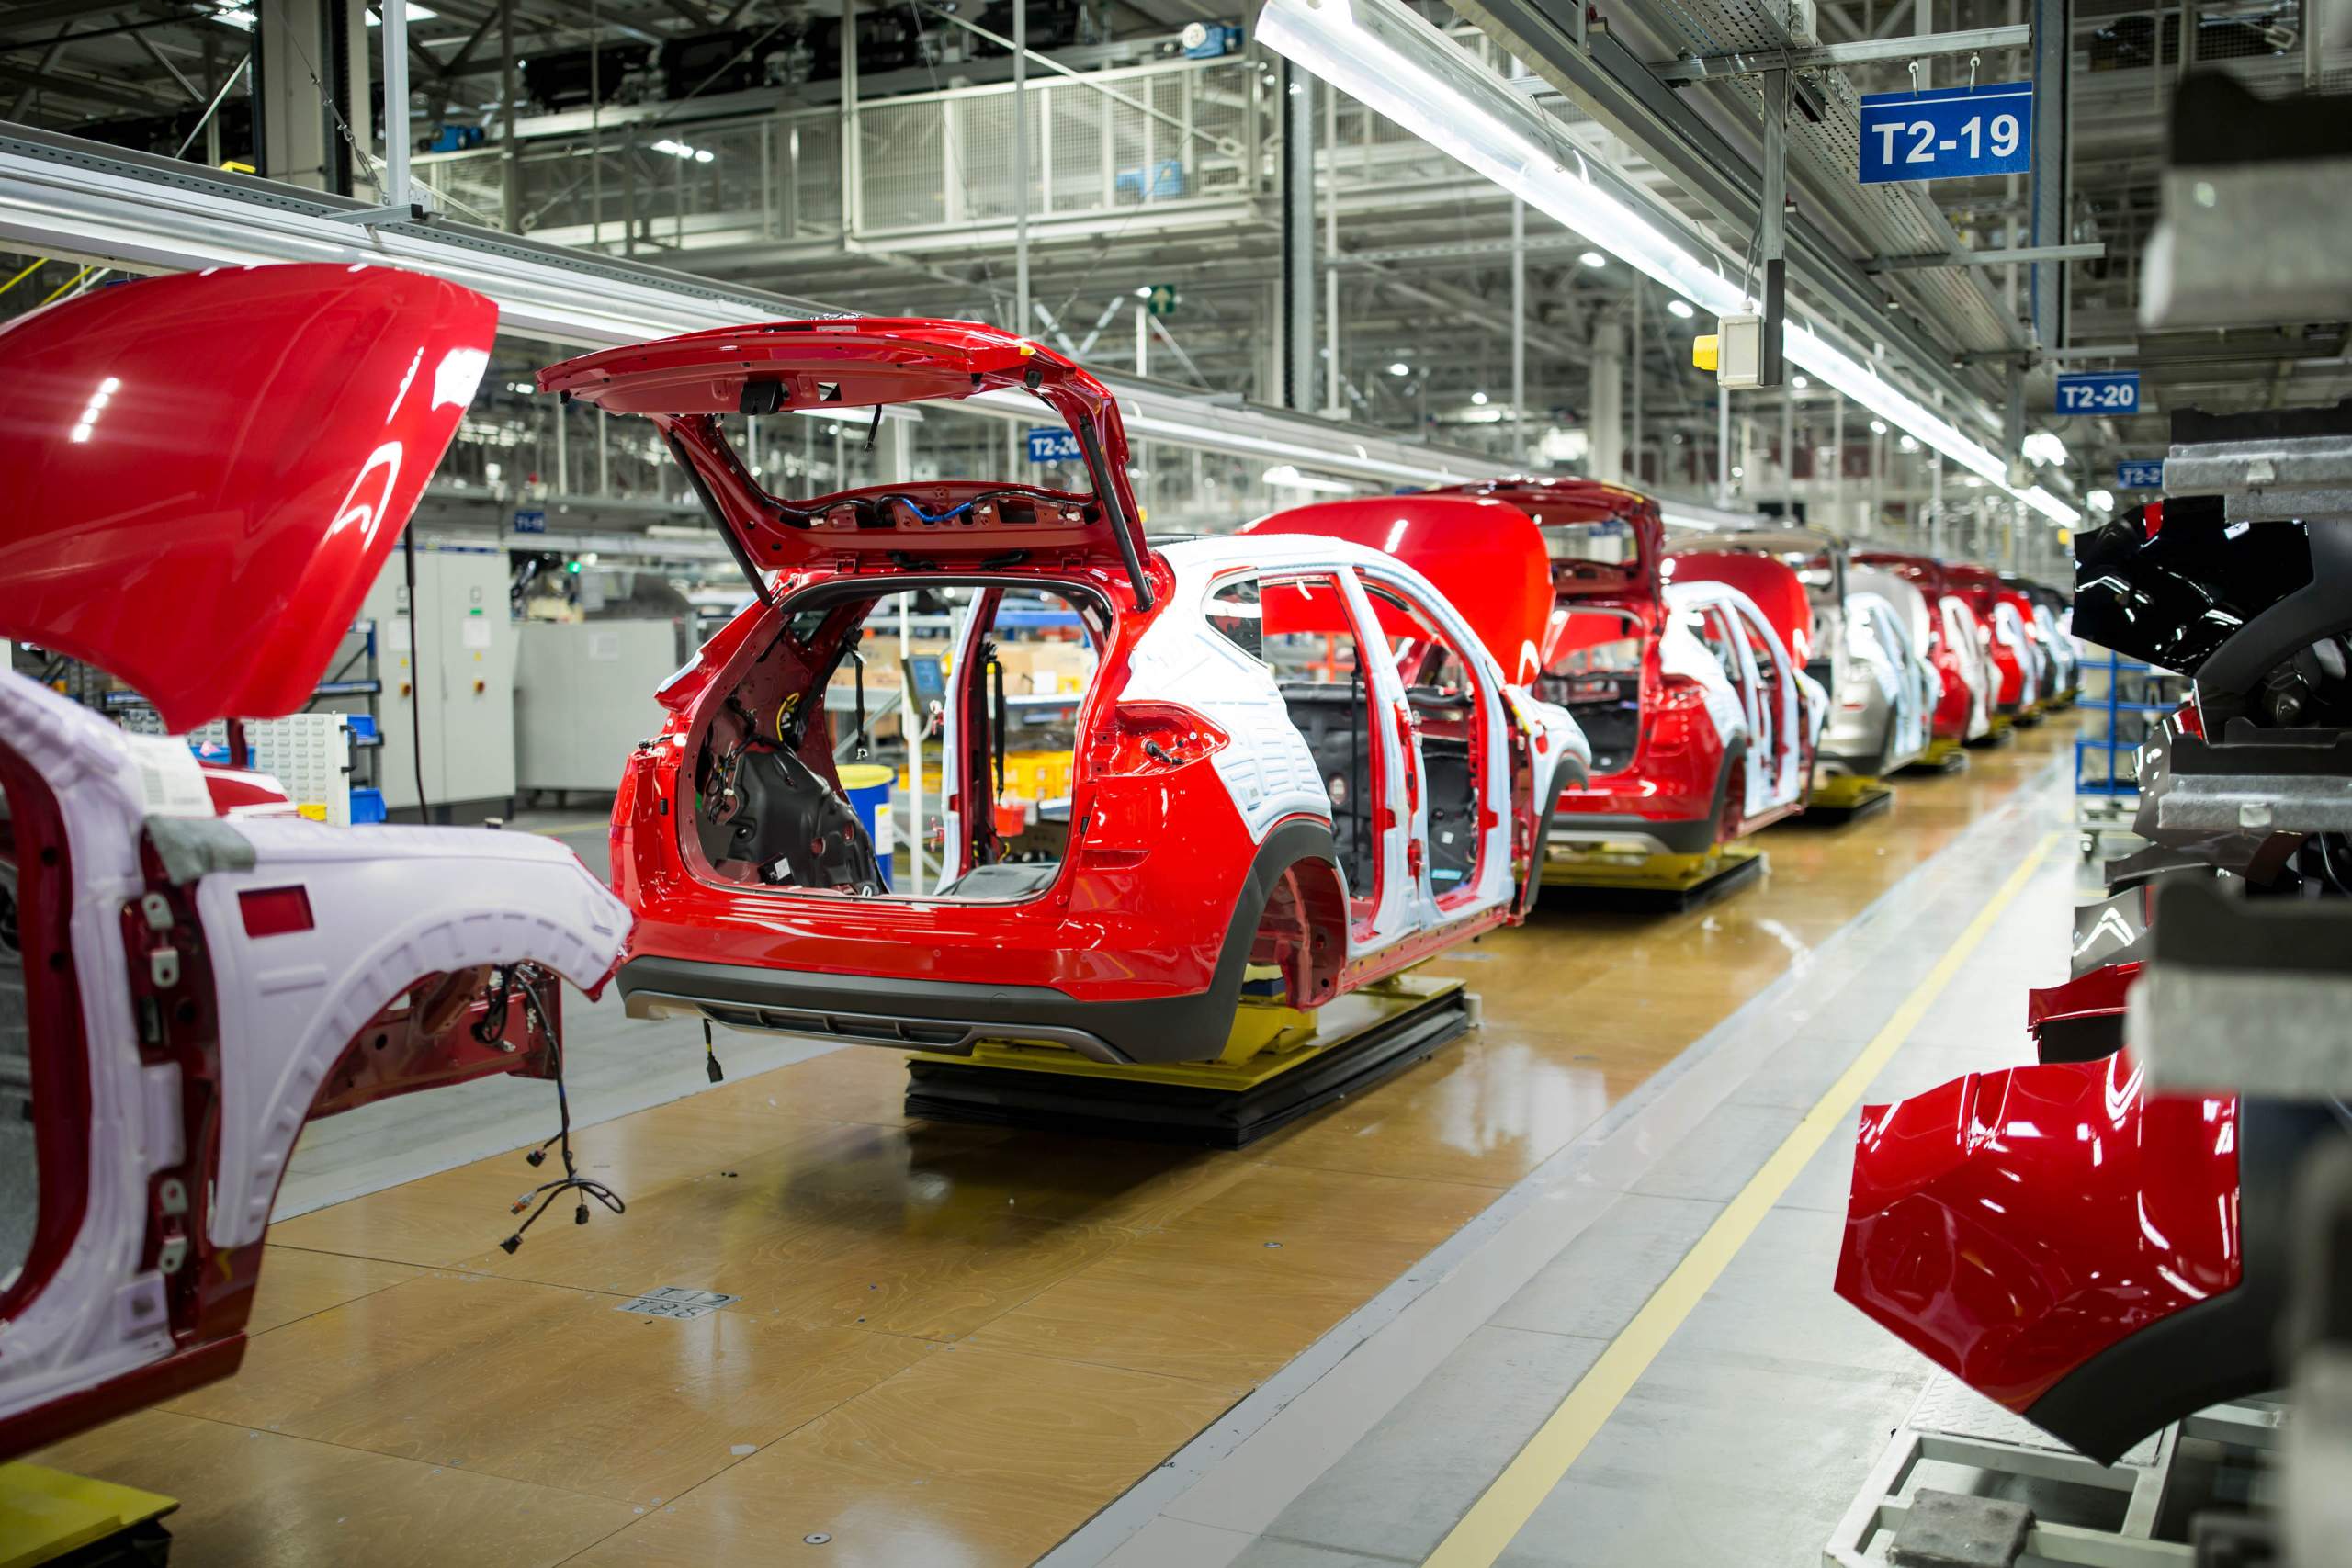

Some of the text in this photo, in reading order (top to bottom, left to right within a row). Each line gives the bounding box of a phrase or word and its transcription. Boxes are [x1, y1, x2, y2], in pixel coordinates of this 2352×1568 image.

[1871, 114, 2019, 165] T2-19
[2061, 384, 2134, 408] T2-20
[2121, 467, 2161, 485] T2-2
